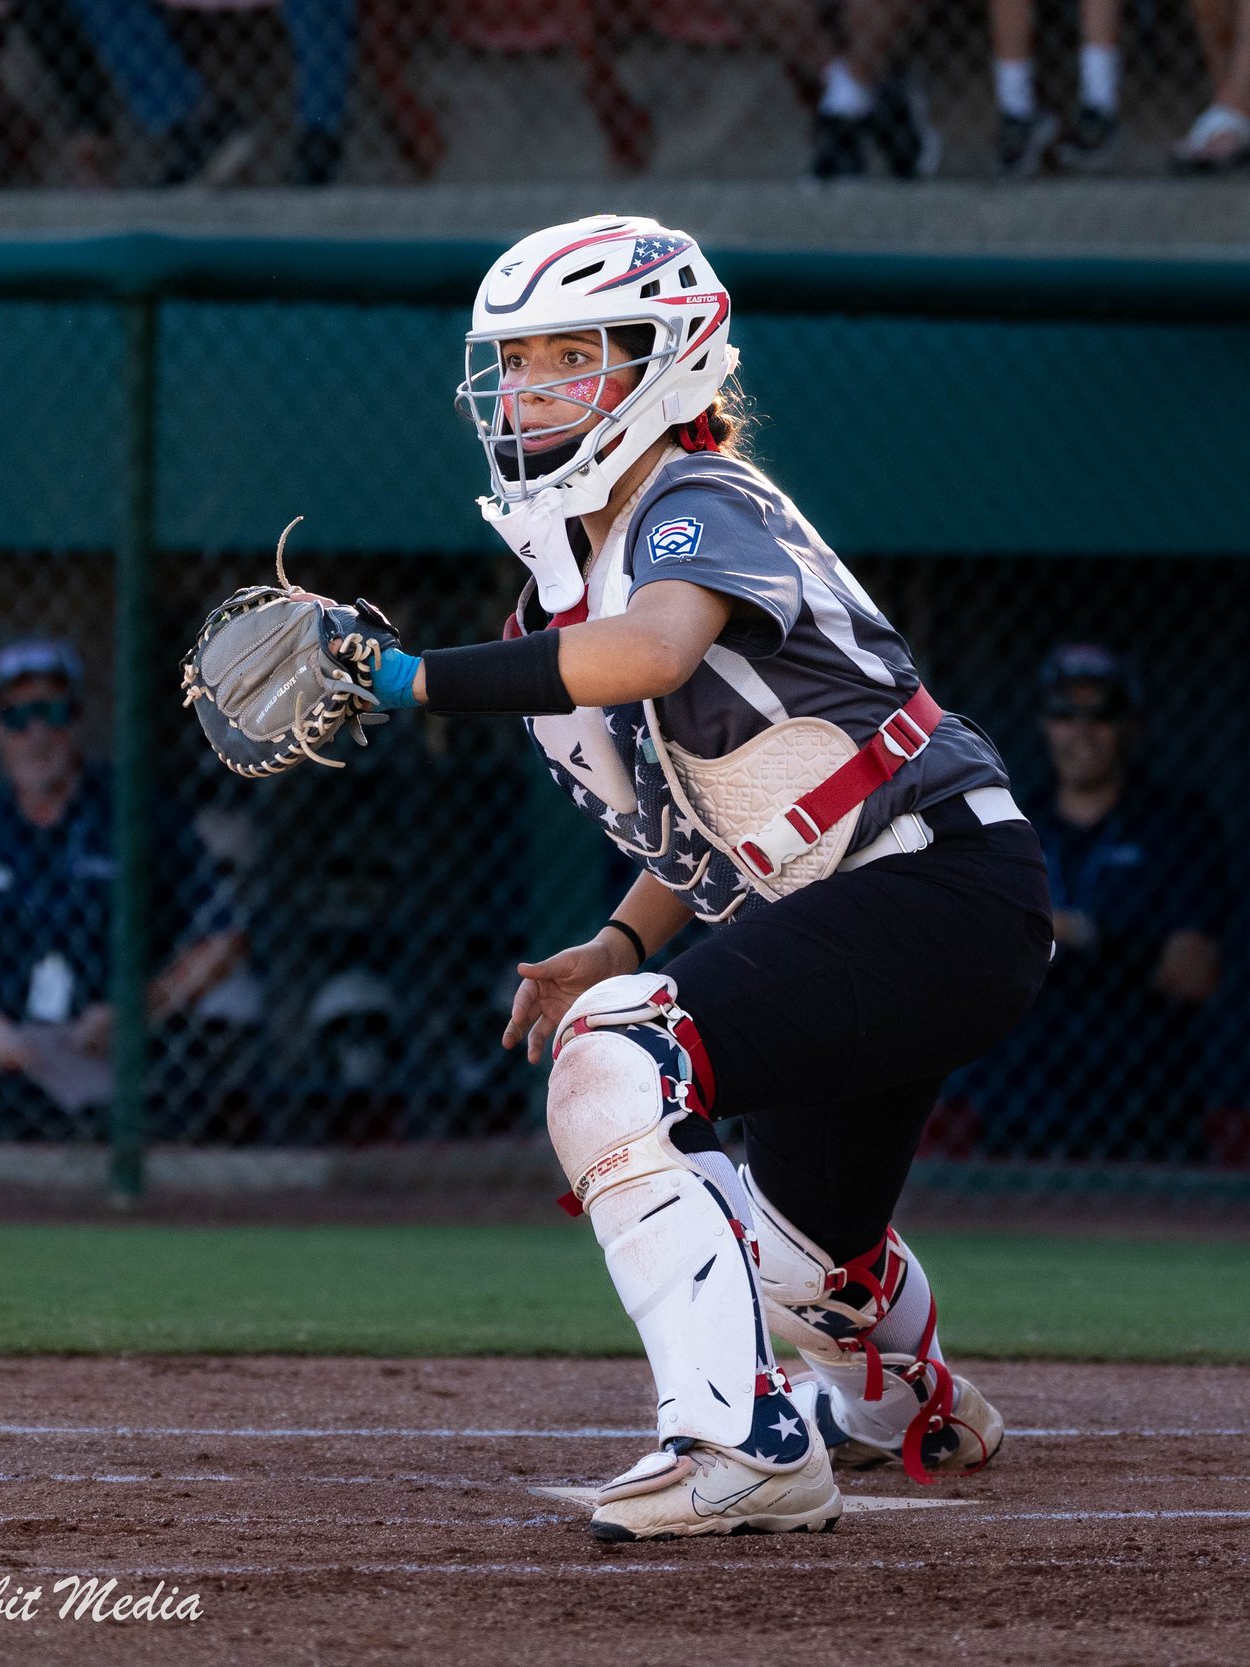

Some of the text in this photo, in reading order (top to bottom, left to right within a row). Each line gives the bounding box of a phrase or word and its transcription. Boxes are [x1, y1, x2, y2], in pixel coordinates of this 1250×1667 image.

[686, 295, 718, 304] EASTON
[264, 696, 278, 713] GOLD
[276, 676, 297, 698] GLOVE
